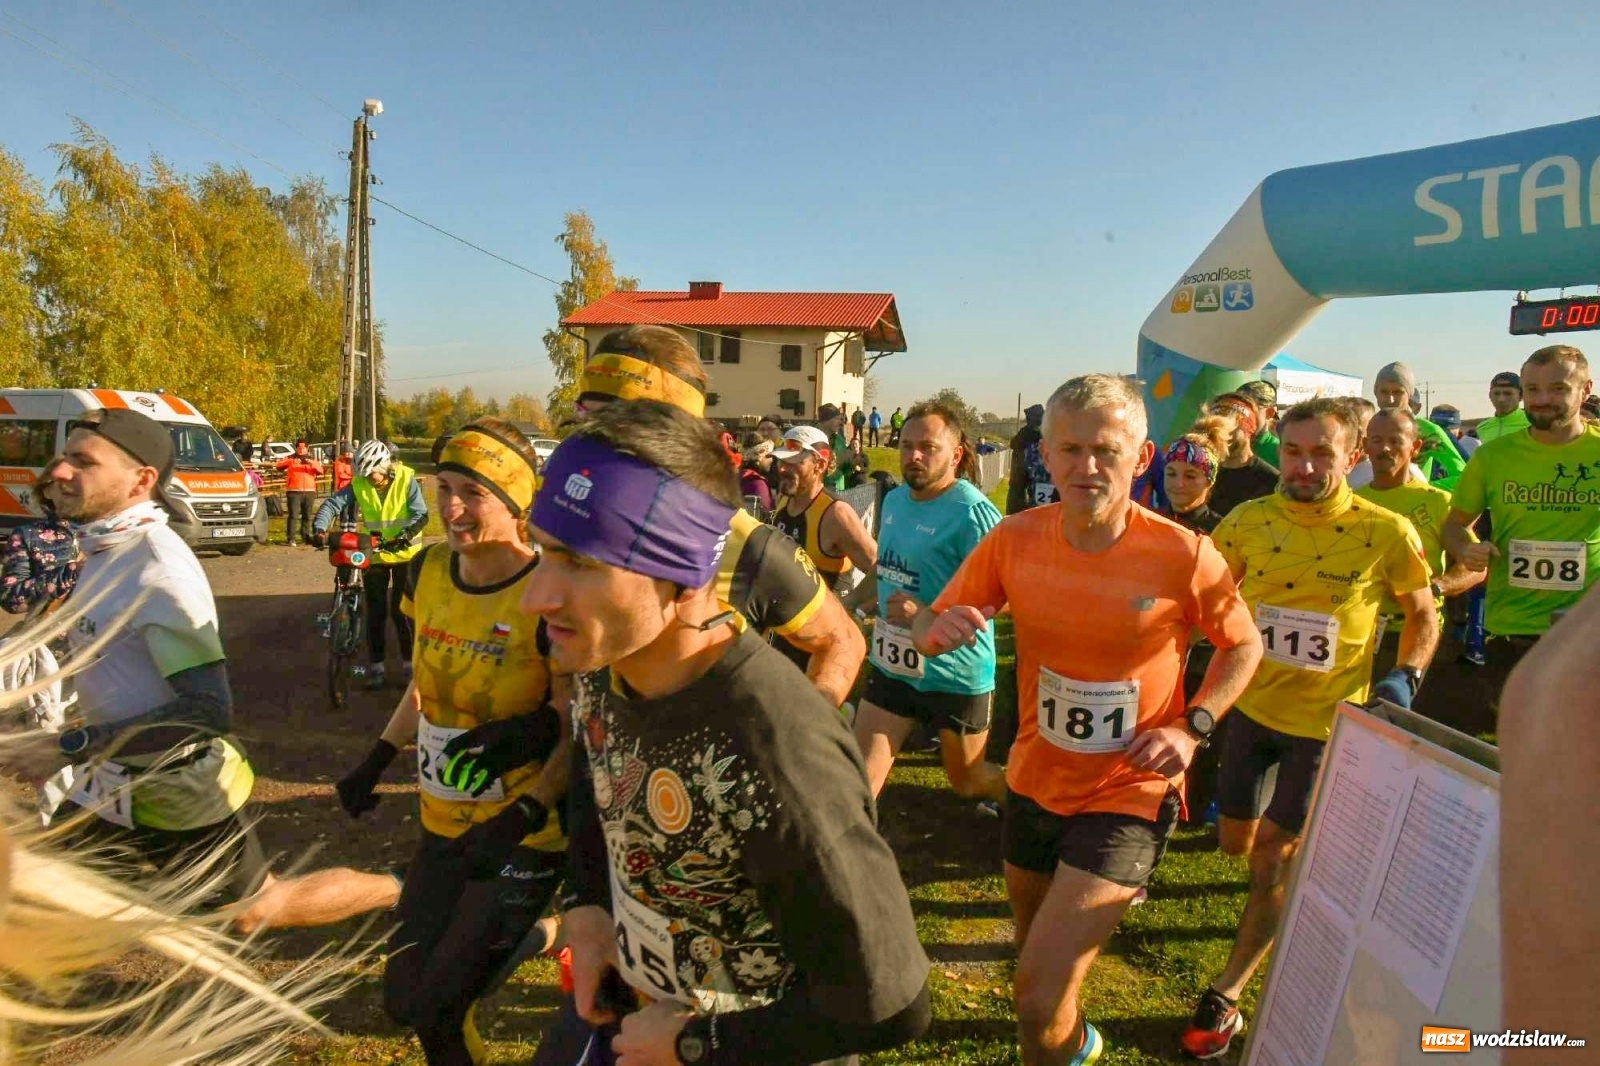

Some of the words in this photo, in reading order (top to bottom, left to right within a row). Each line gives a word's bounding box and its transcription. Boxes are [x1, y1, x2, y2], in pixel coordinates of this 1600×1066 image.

[1413, 155, 1600, 247] STA
[1512, 557, 1580, 582] 208
[876, 636, 919, 669] 130
[1261, 625, 1330, 662] 113
[1042, 697, 1125, 740] 181
